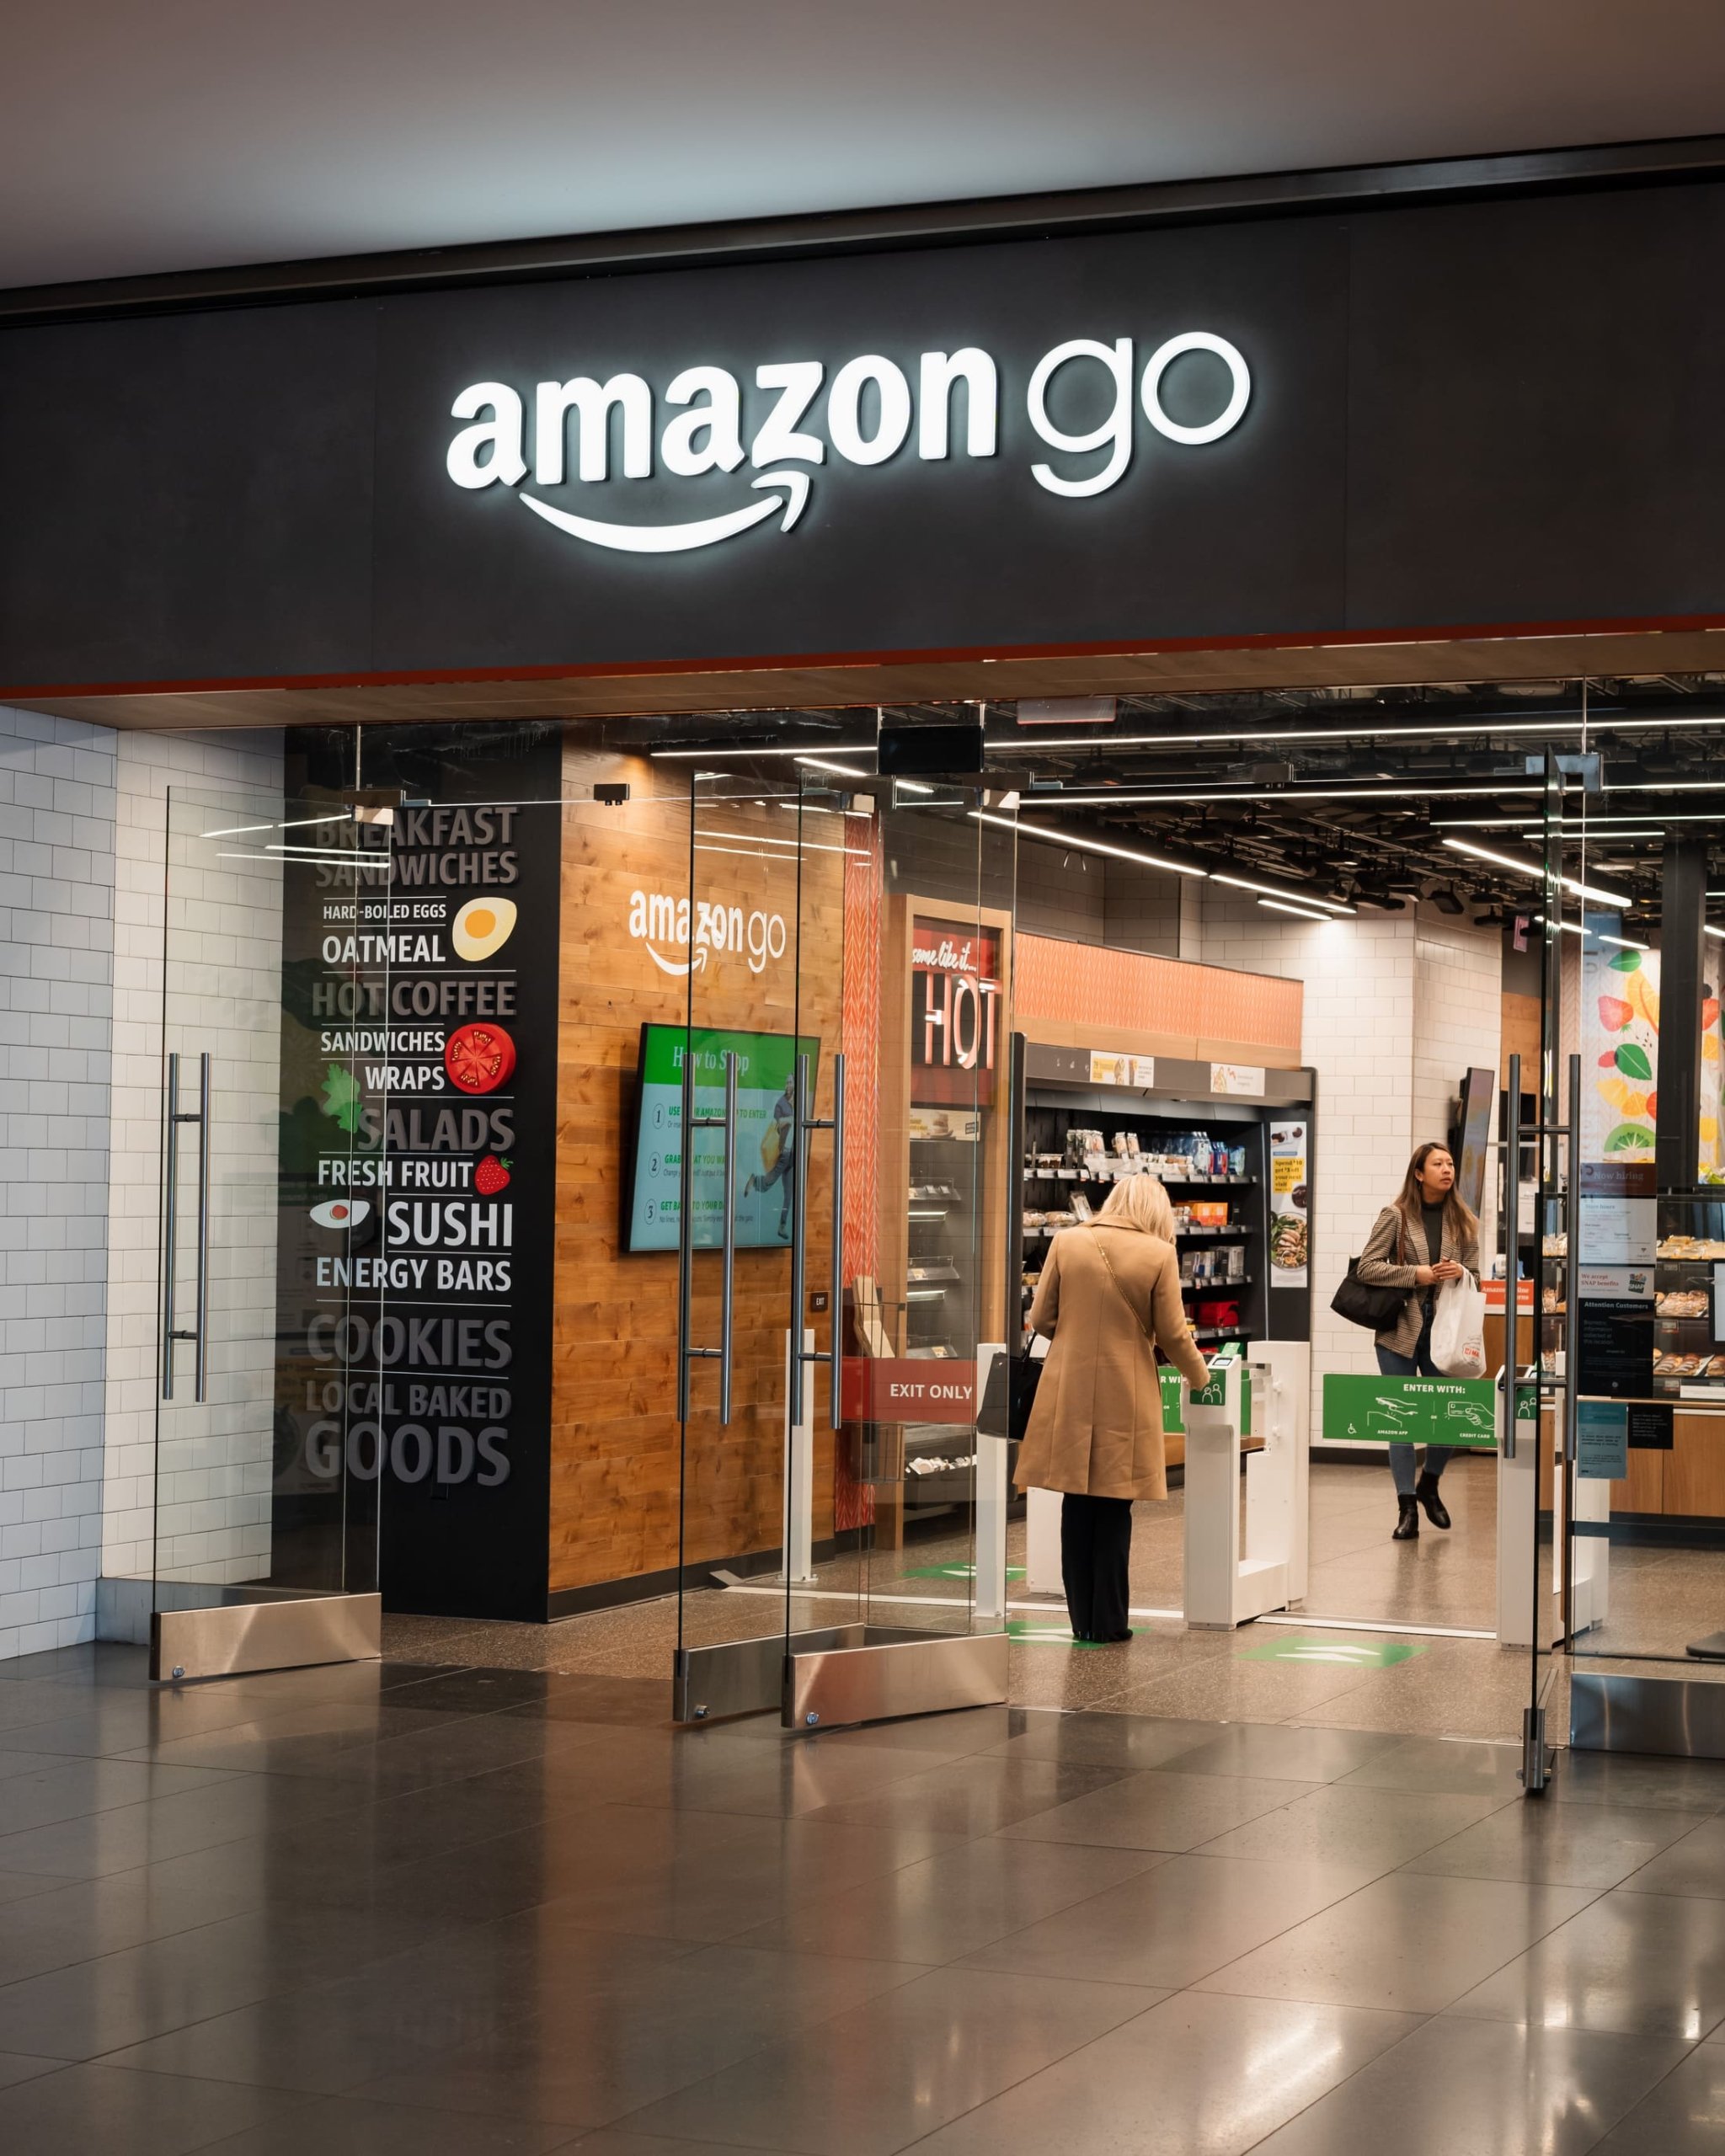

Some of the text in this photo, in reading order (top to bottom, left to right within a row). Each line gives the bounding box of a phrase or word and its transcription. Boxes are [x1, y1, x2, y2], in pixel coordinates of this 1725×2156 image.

[446, 331, 1251, 498] amazon go
[315, 807, 519, 851] BREAKFAST
[315, 851, 519, 888] SANDWICHES
[323, 904, 446, 920] HARD-BOILED EGGS
[322, 935, 446, 963] OATMEAL
[629, 889, 787, 974] amazon go
[937, 941, 959, 969] like
[312, 980, 518, 1017] HOT COFFEE
[925, 973, 1002, 1070] HOT
[320, 1031, 446, 1053] SANDWICHES
[705, 1050, 717, 1069] to
[365, 1065, 445, 1091] WRAPS
[669, 1106, 681, 1116] USE
[357, 1107, 515, 1151] SALADS
[318, 1159, 473, 1188] FRESH FRUIT
[1594, 1171, 1615, 1180] Now
[387, 1201, 512, 1247] SUSHI
[316, 1257, 512, 1292] ENERGY BARS
[307, 1313, 513, 1369] COOKIES
[306, 1380, 512, 1421] LOCAL BAKED
[890, 1384, 973, 1400] EXIT ONLY
[1403, 1384, 1466, 1395] ENTER WITH:
[305, 1420, 511, 1487] GOODS
